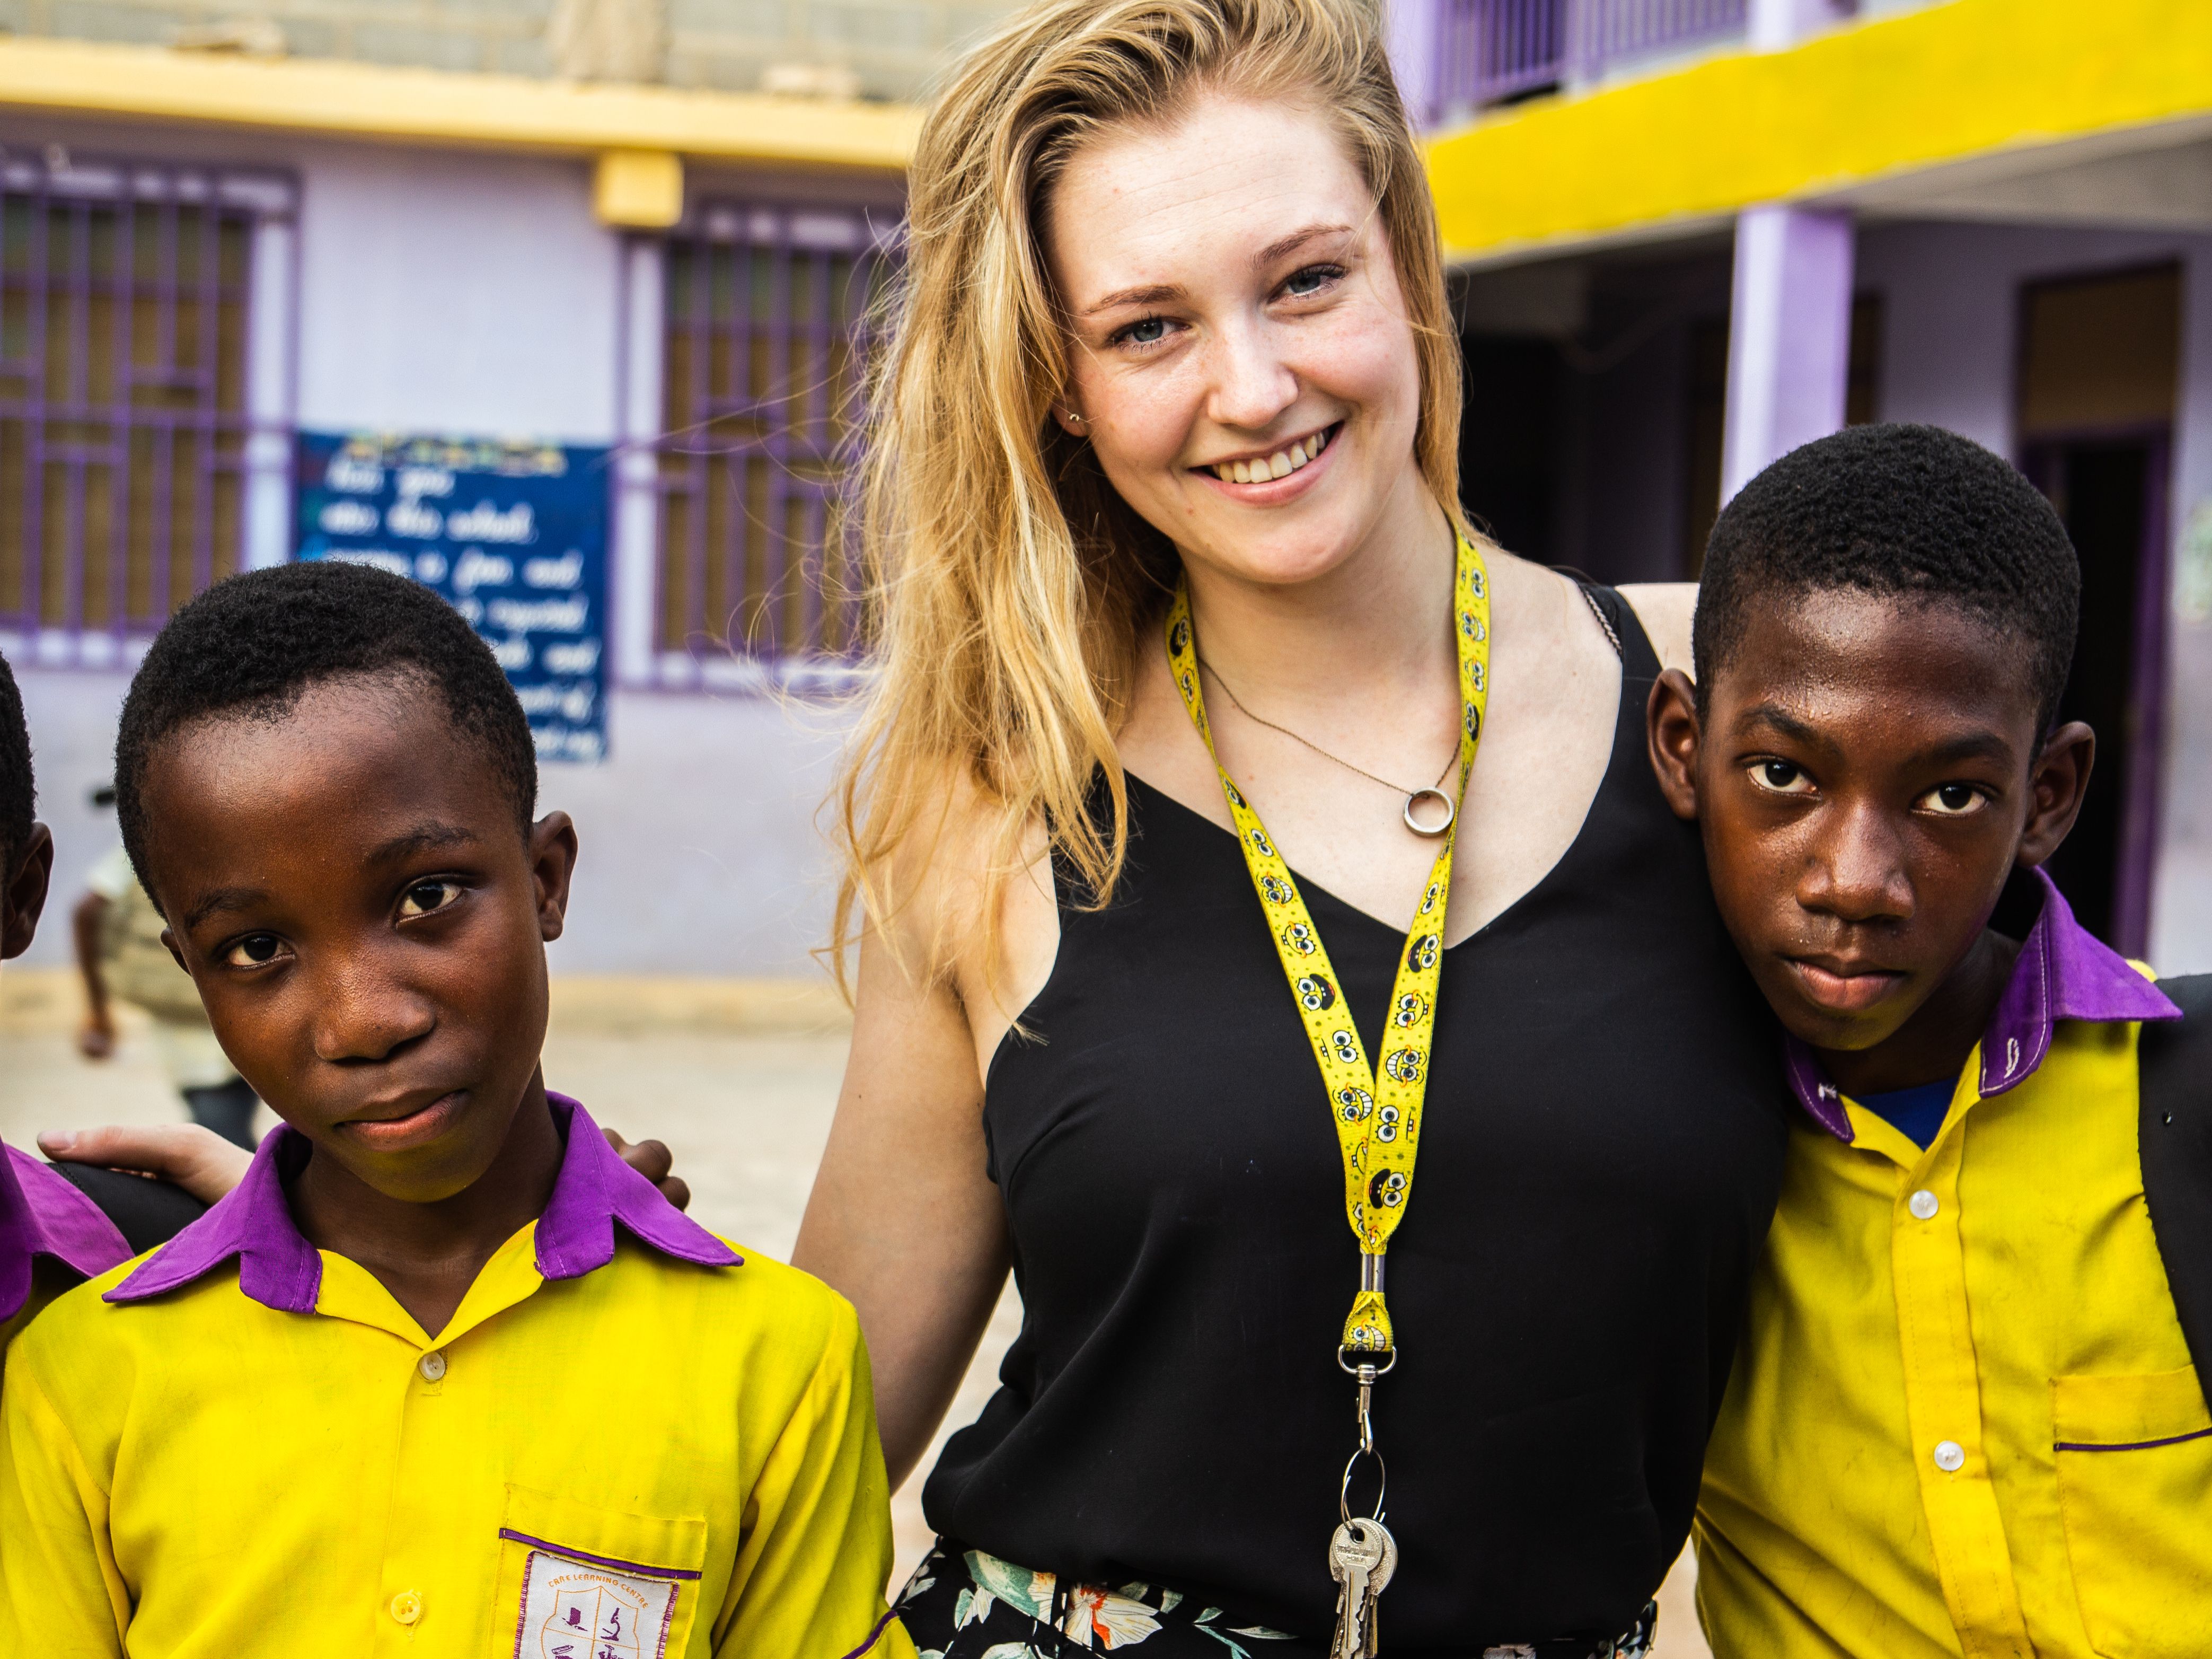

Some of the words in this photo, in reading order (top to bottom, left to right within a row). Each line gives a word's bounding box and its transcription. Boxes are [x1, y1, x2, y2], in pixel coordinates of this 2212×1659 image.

[549, 1575, 571, 1587] CARE
[573, 1574, 619, 1586] LEARNING
[621, 1583, 649, 1609] CENTRE
